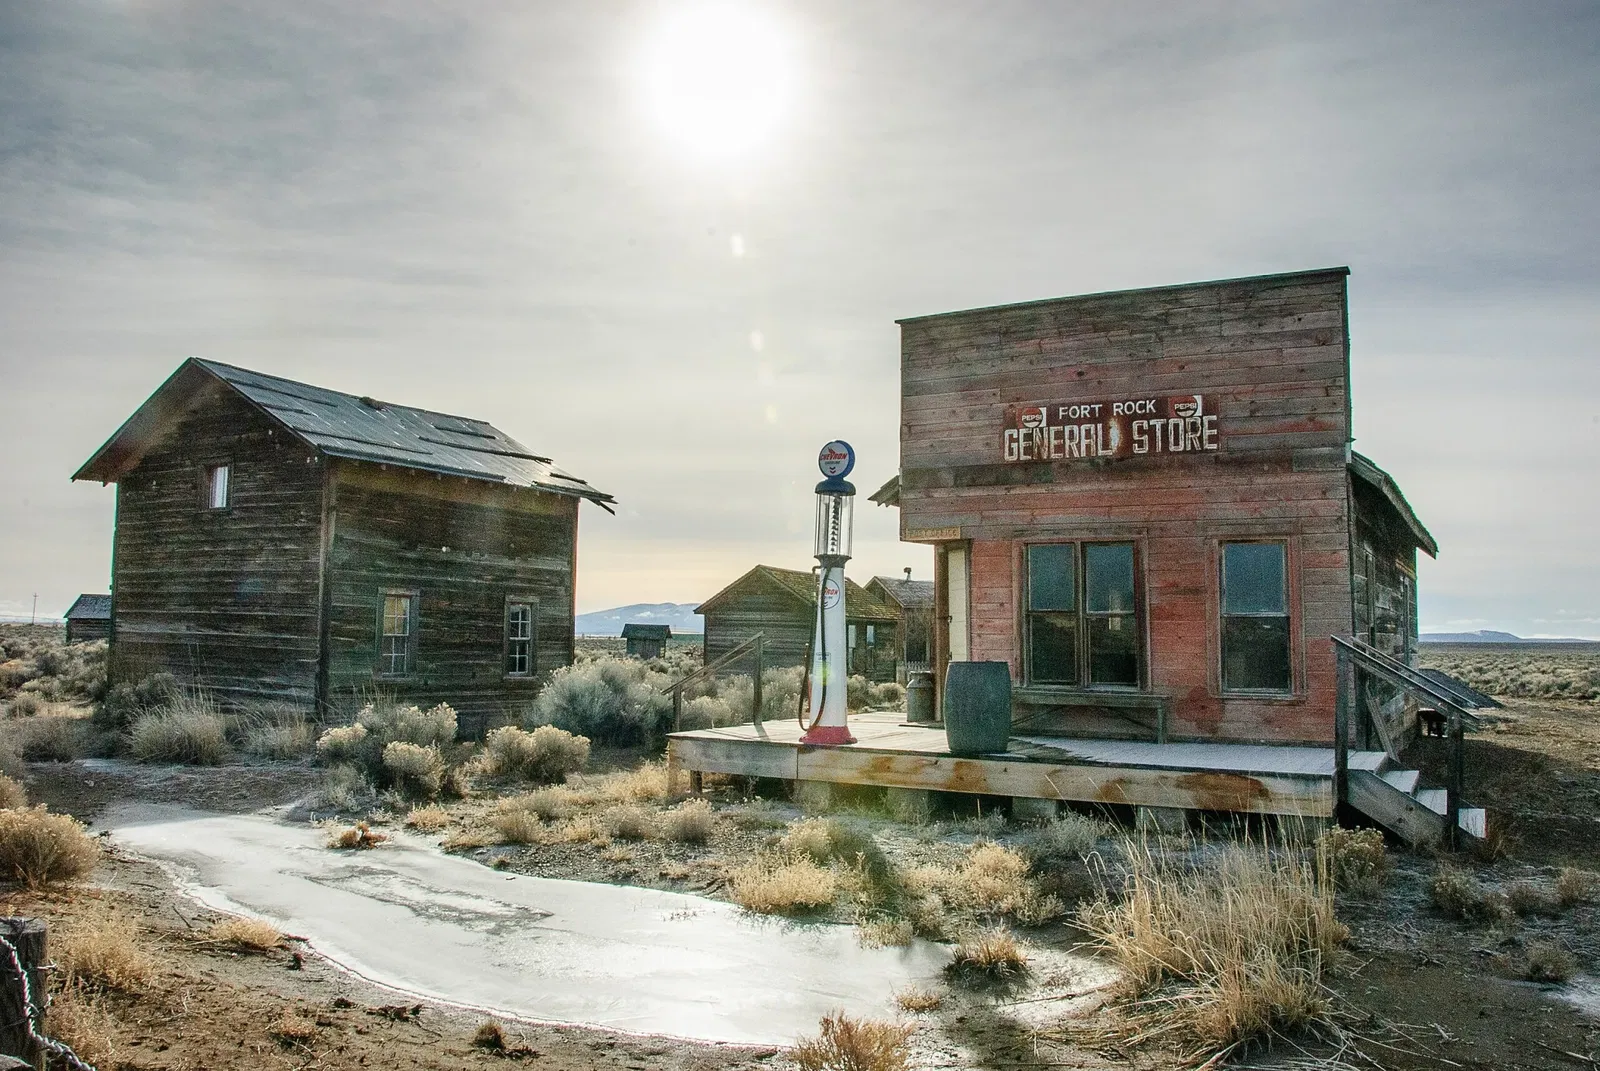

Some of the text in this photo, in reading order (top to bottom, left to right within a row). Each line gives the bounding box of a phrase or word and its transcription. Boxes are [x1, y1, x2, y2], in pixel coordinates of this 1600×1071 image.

[1059, 399, 1157, 420] FORT ROCK
[1174, 402, 1197, 410] PEPSI
[1004, 415, 1218, 461] GENERAL STORE
[820, 450, 848, 460] CHEVRON
